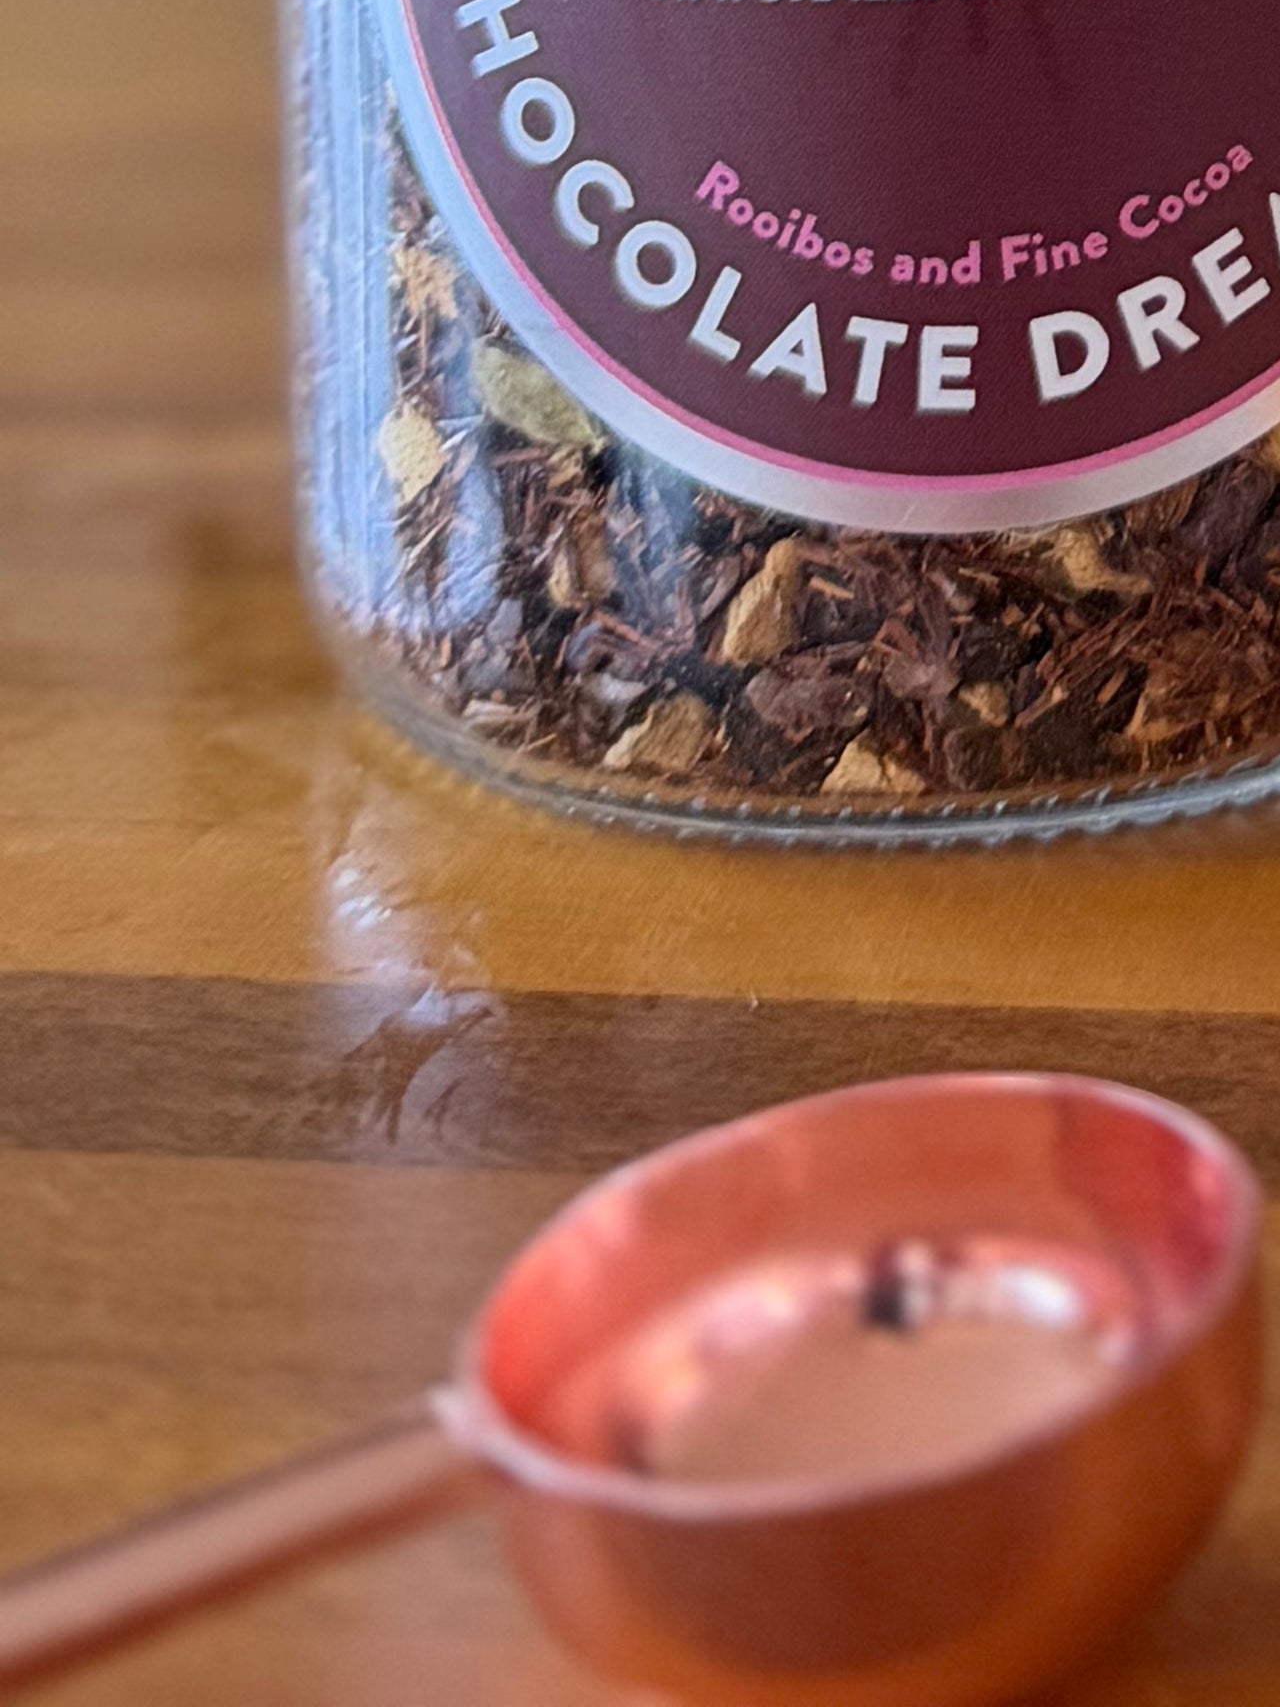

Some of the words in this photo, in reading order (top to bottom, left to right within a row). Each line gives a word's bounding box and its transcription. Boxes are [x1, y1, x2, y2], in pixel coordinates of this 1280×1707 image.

[695, 161, 874, 276] Rooibos
[890, 241, 981, 285] and
[1000, 232, 1109, 282] Fine
[1119, 144, 1253, 239] Cocoa
